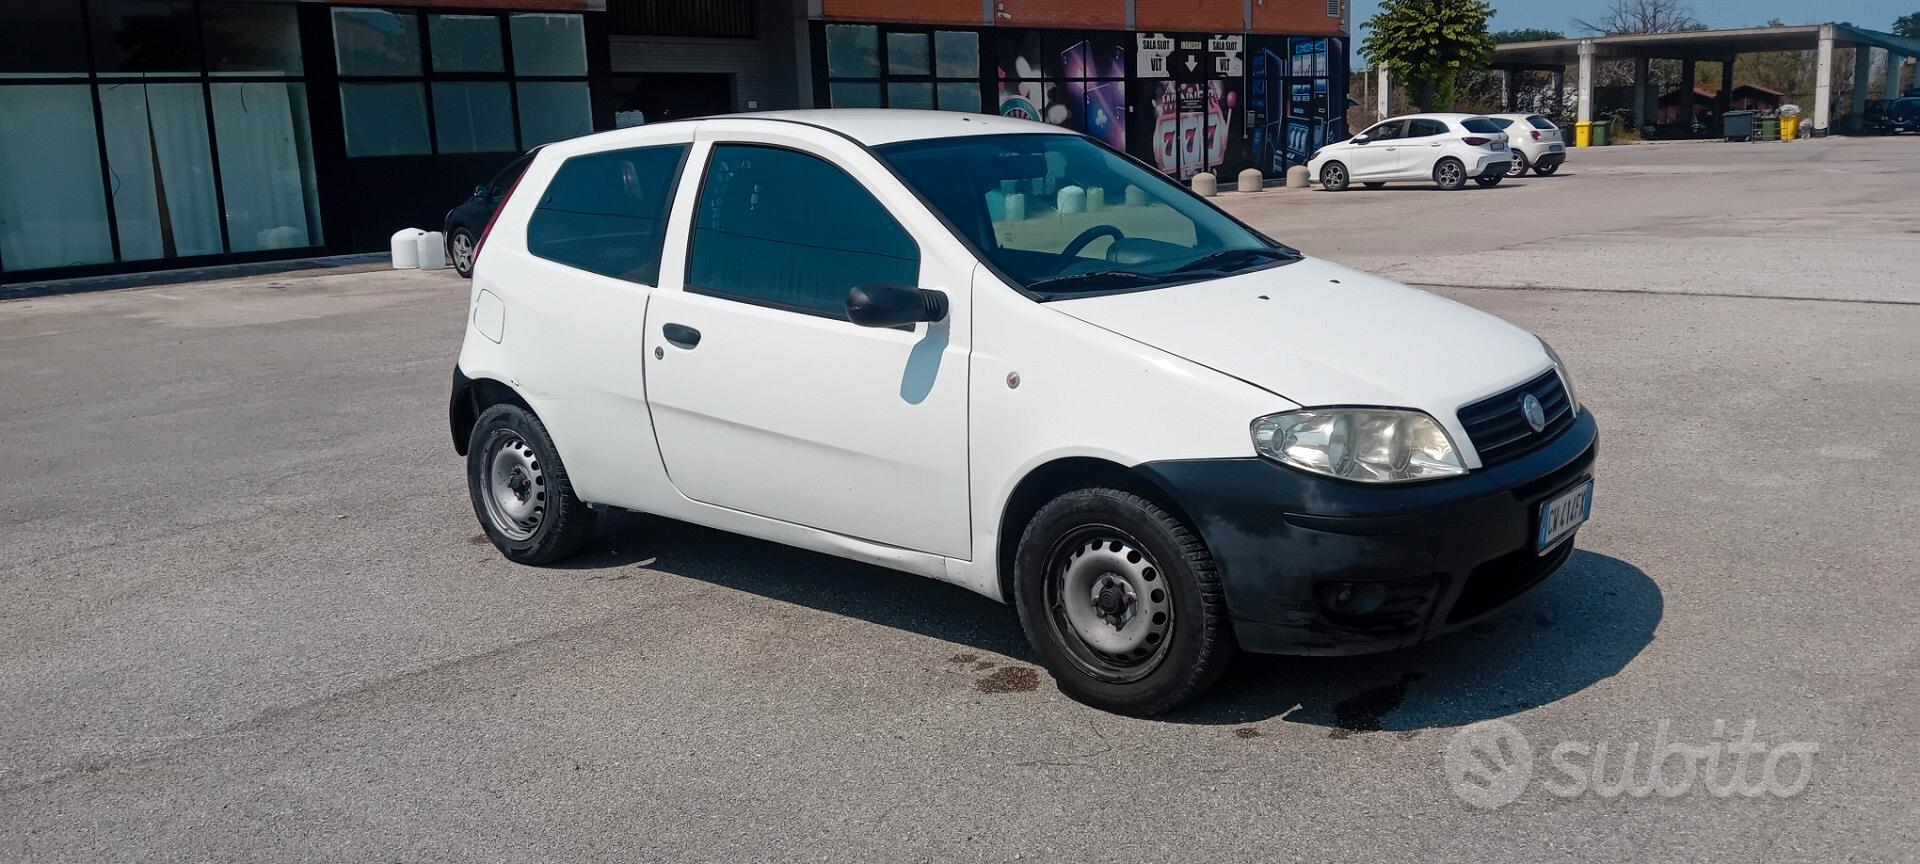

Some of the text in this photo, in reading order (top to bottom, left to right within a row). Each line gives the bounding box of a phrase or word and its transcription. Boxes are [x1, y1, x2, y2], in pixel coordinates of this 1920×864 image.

[1143, 40, 1170, 50] SALA SLOT
[1213, 41, 1237, 51] SALA SLOT
[1150, 58, 1163, 72] VLT
[1219, 58, 1231, 72] VLT
